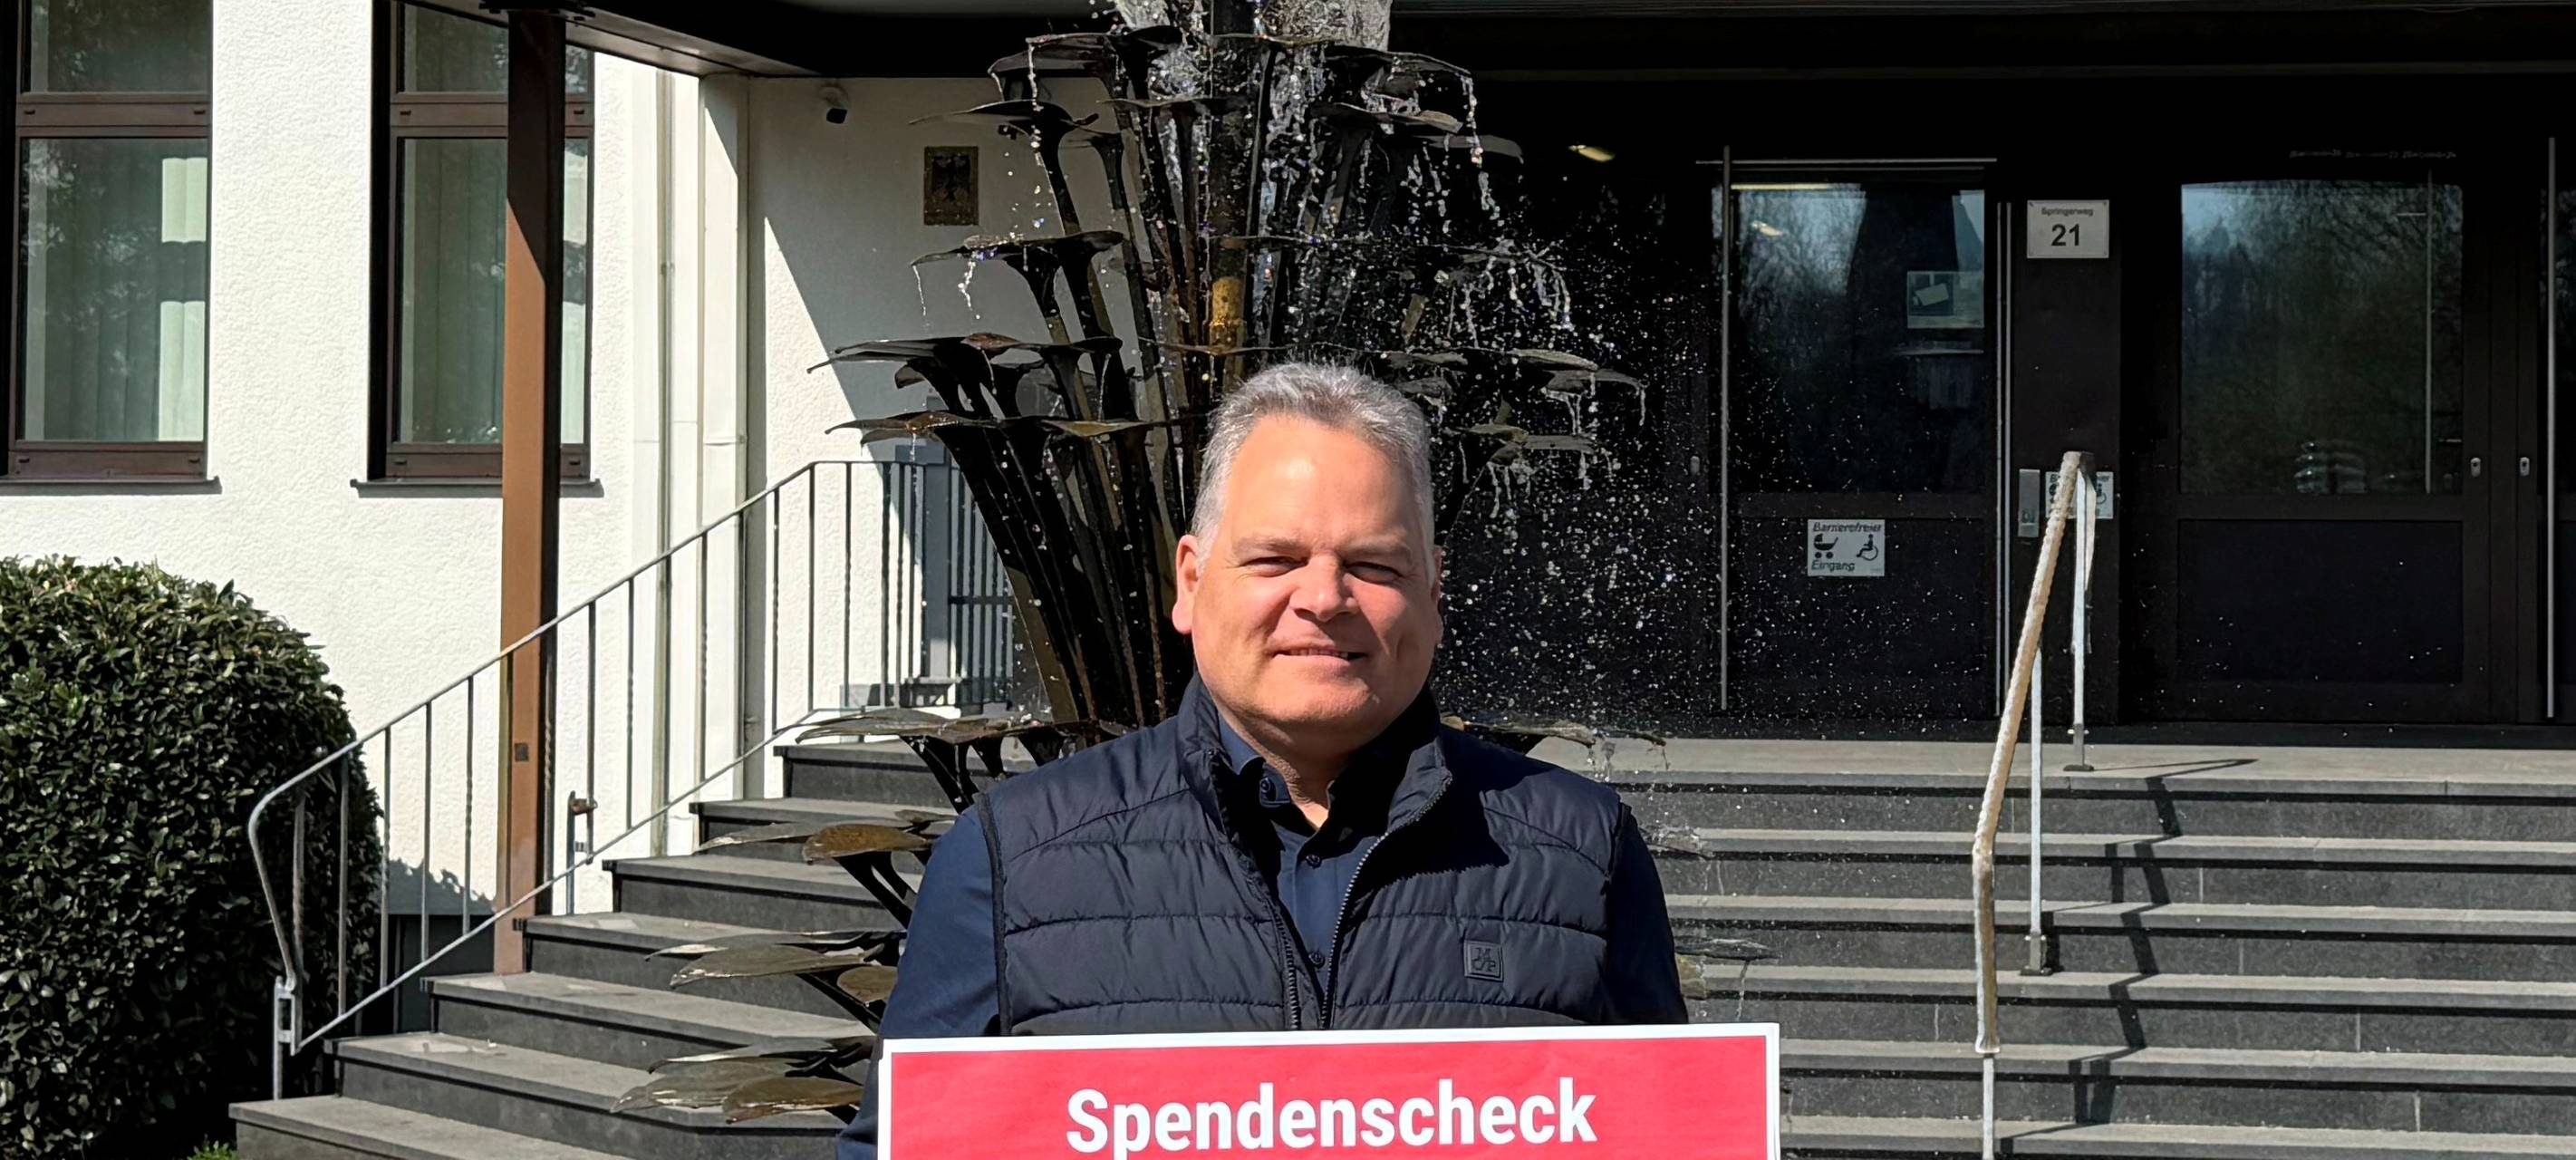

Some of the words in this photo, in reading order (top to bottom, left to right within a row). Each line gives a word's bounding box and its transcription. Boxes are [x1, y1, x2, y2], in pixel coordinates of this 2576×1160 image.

[2041, 207, 2093, 217] Springerweg
[2051, 223, 2079, 246] 21
[1813, 521, 1882, 533] Barrierefreier
[1811, 560, 1855, 572] Eingang
[1066, 1077, 1597, 1160] Spendenscheck
